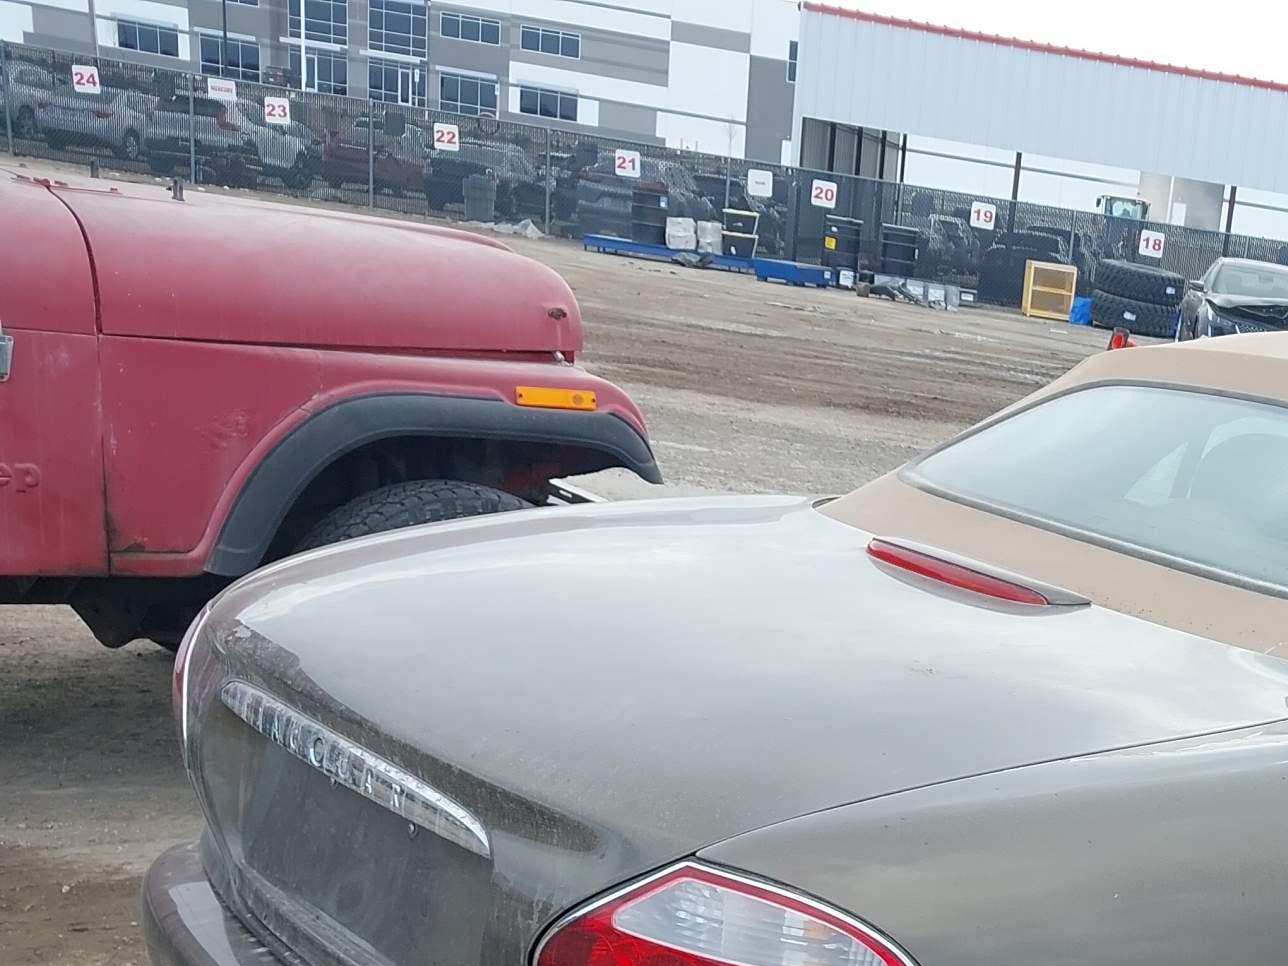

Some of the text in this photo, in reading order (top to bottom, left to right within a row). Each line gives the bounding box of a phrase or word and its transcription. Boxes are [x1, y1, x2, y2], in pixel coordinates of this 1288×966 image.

[75, 72, 97, 87] 24
[266, 103, 288, 118] 23
[436, 130, 457, 145] 22
[617, 156, 636, 171] 21
[813, 186, 835, 201] 20
[973, 208, 994, 223] 19
[1142, 236, 1162, 252] 18
